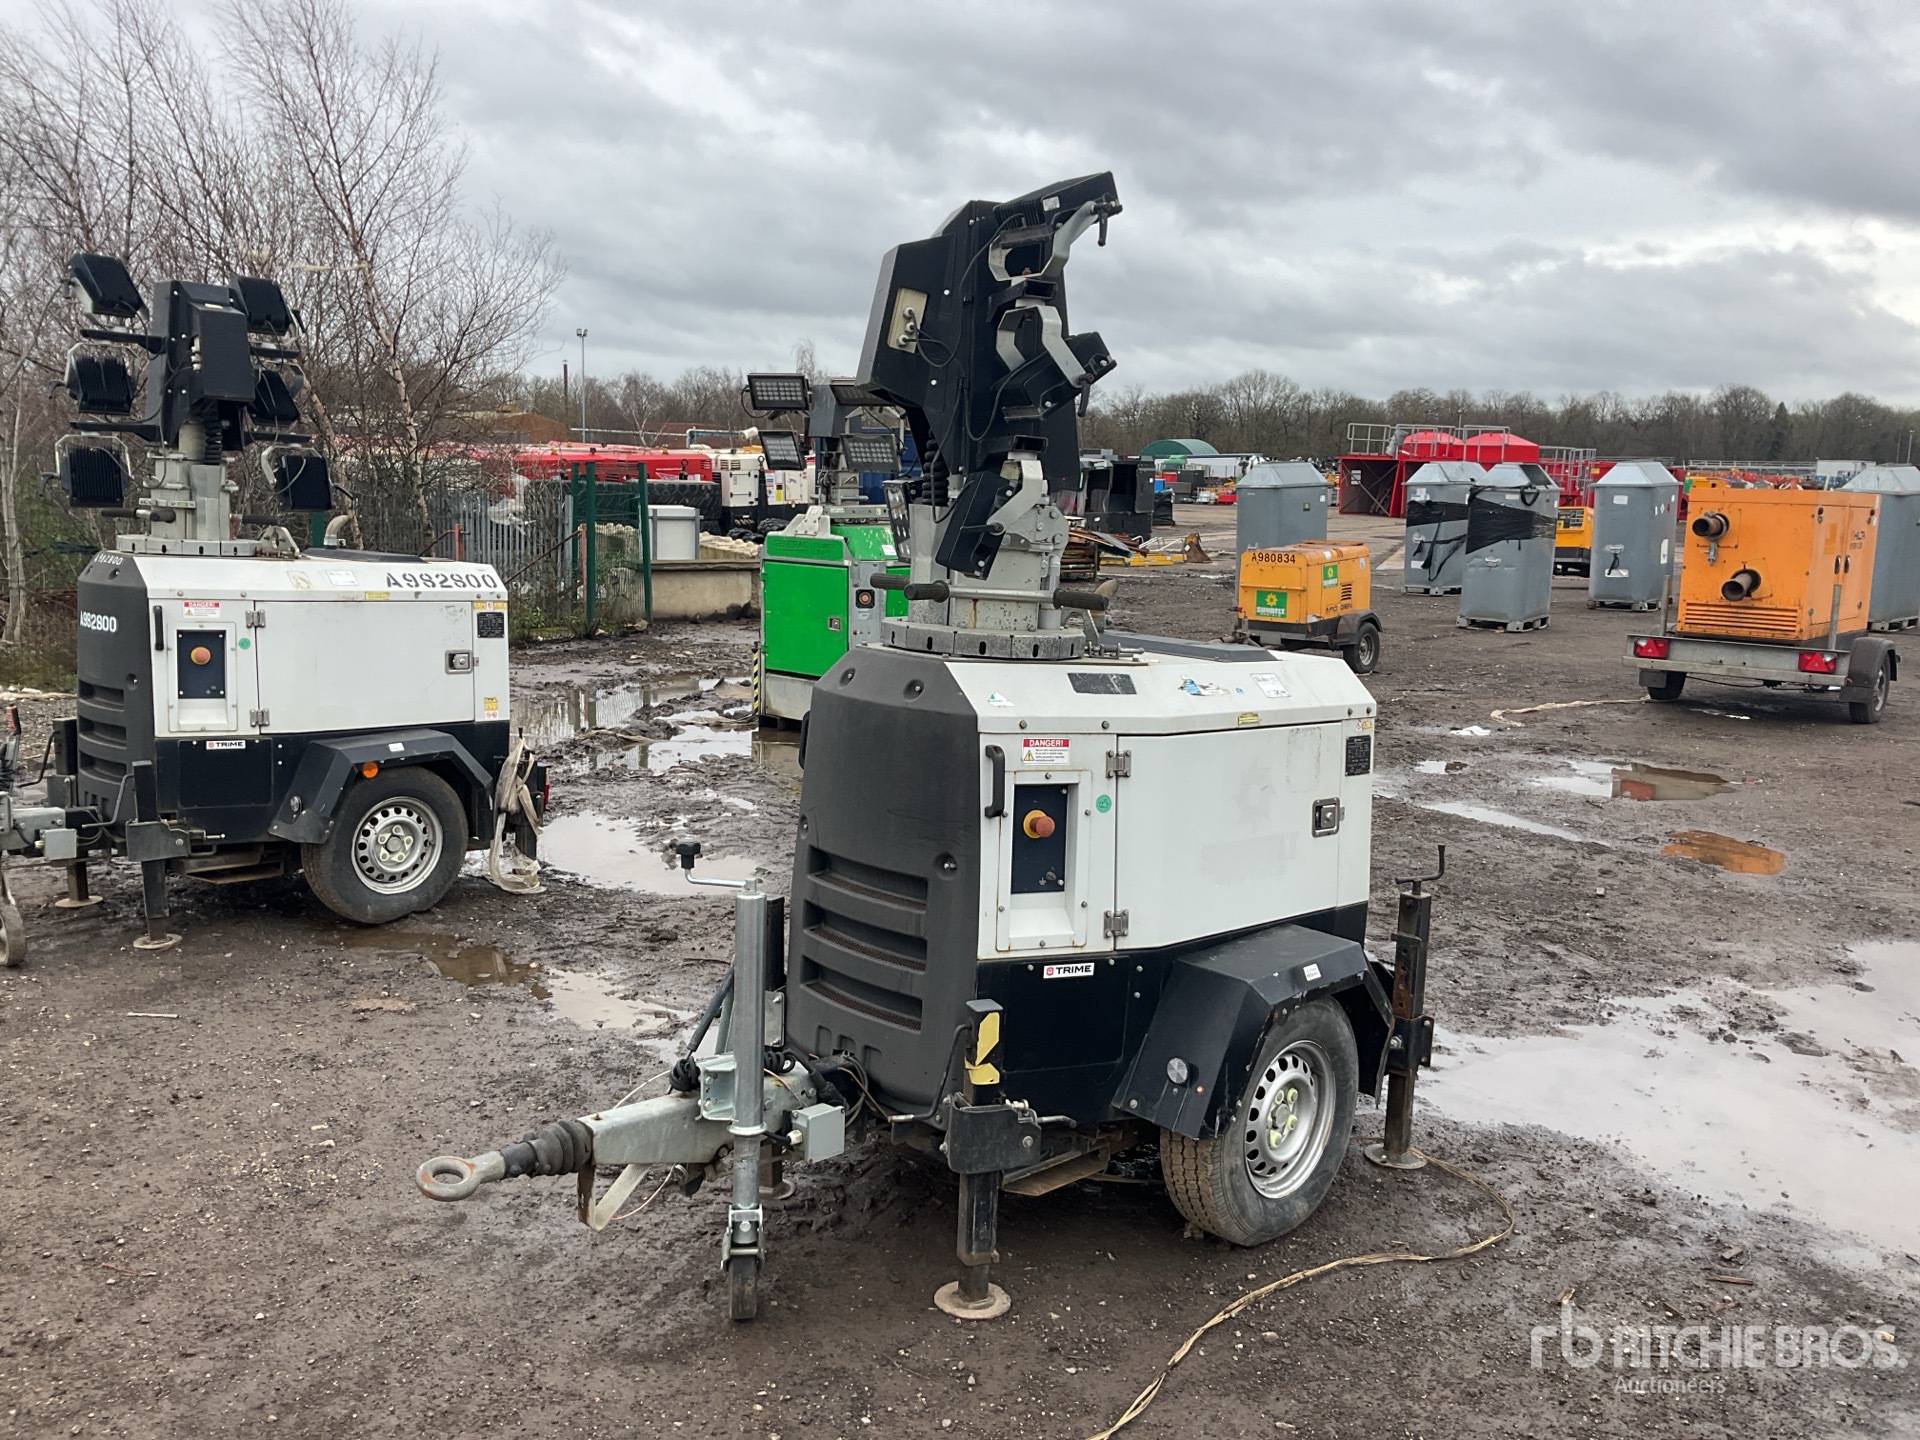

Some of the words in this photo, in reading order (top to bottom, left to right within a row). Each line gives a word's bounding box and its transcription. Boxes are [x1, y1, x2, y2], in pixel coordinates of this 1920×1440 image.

[1251, 552, 1296, 564] A980834
[386, 572, 498, 588] A982800
[79, 610, 117, 633] A982800
[1029, 739, 1064, 747] DANGER!
[1056, 964, 1092, 975] TRIME
